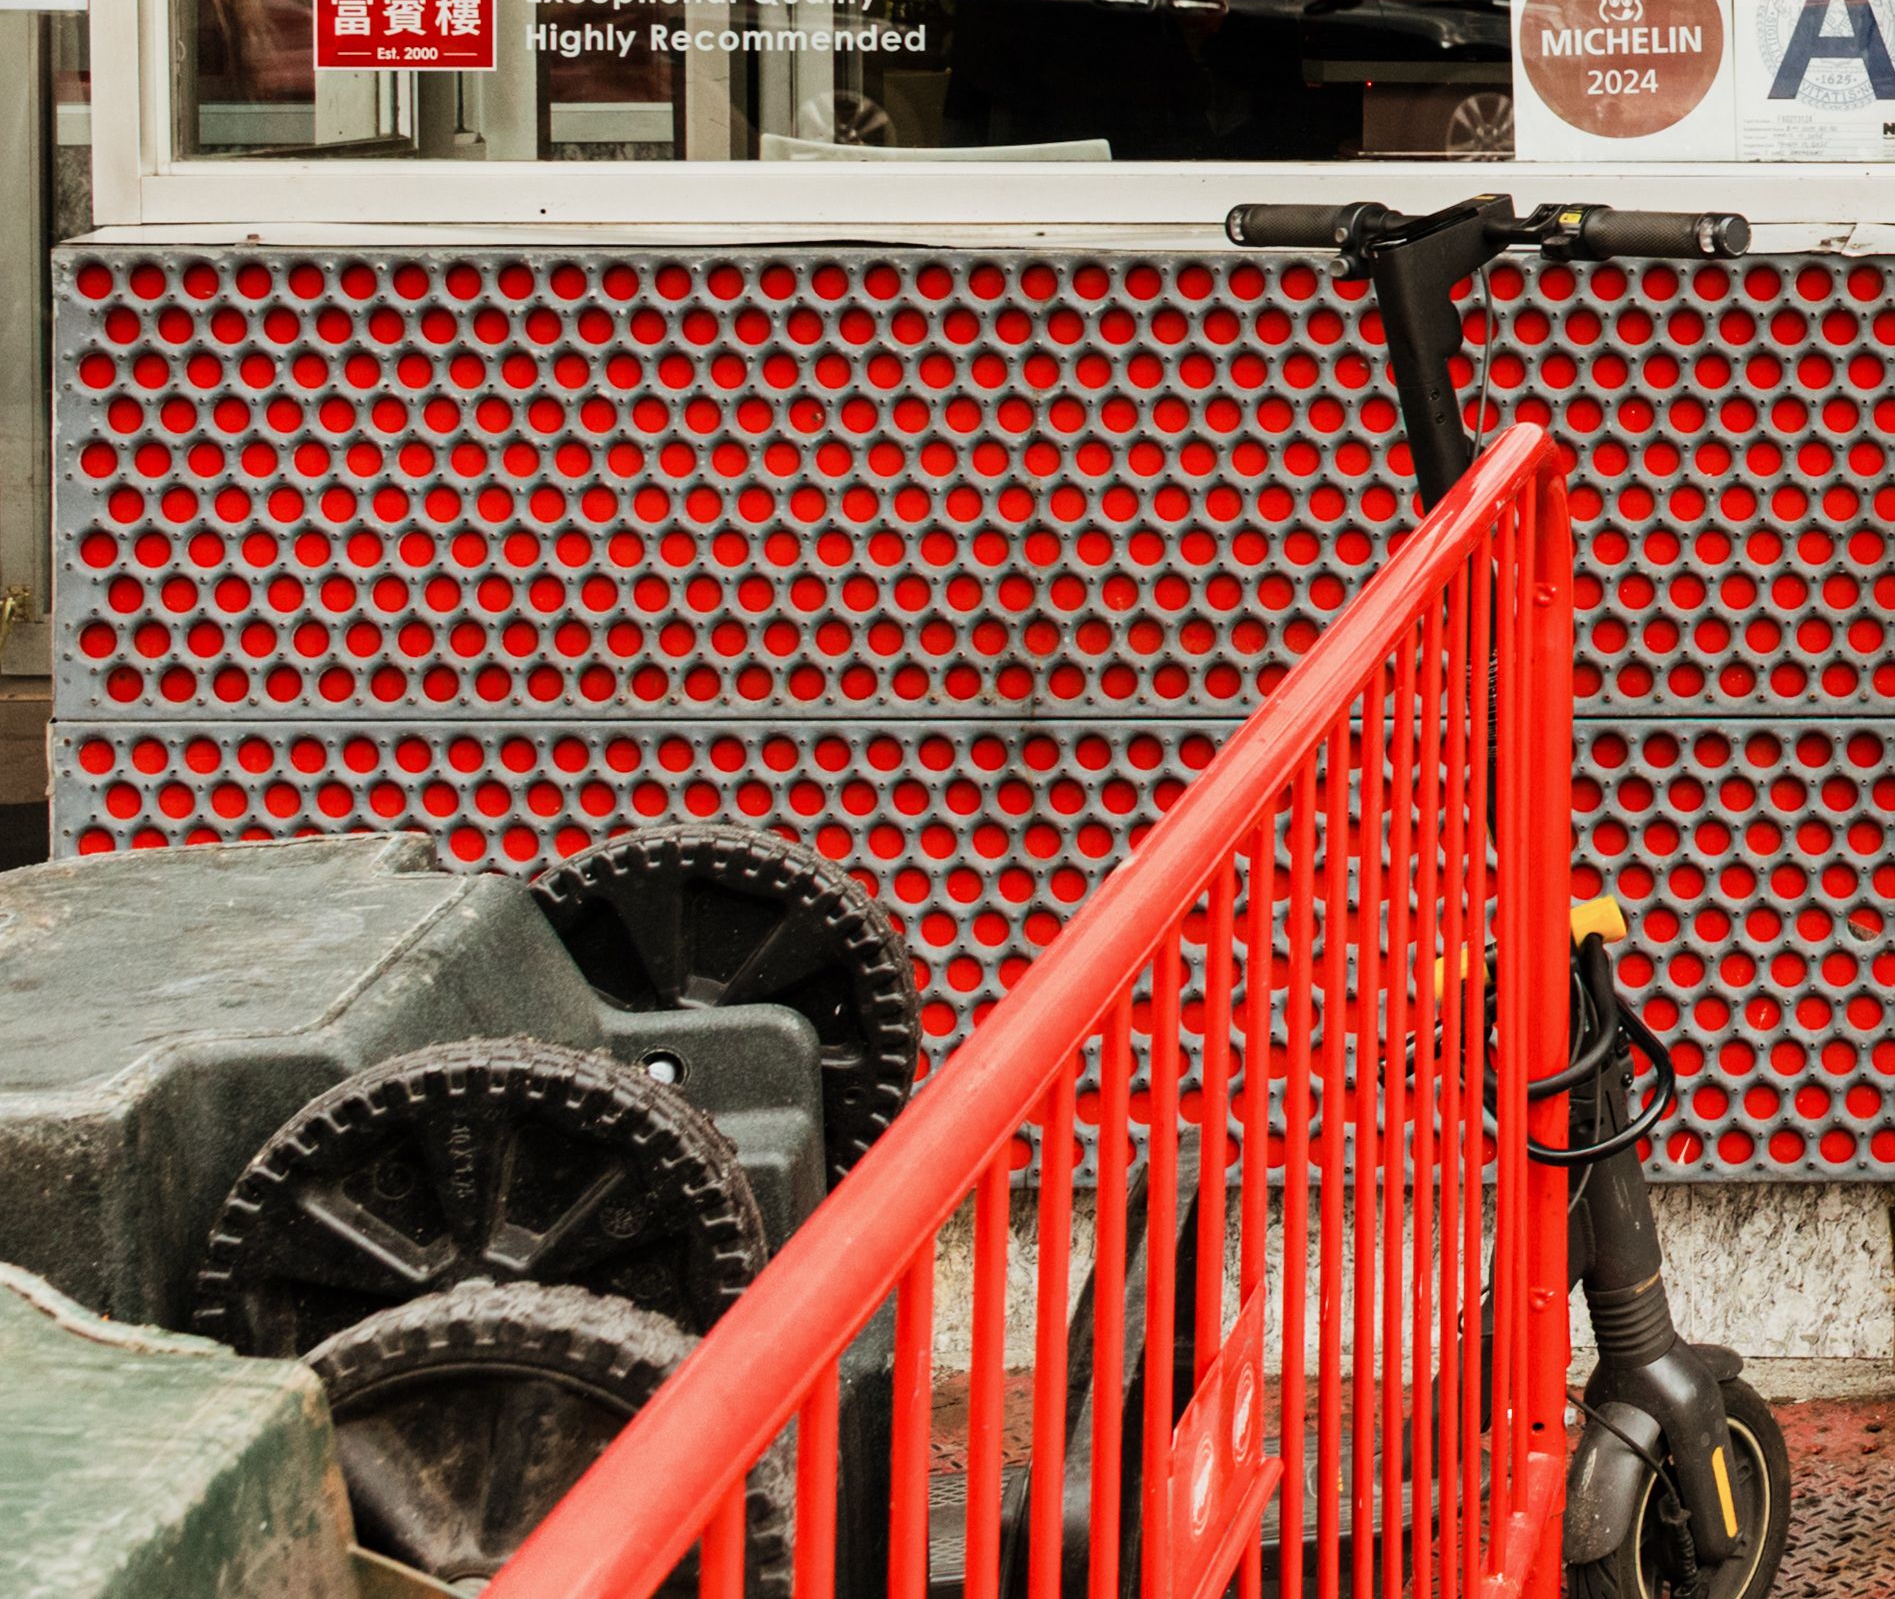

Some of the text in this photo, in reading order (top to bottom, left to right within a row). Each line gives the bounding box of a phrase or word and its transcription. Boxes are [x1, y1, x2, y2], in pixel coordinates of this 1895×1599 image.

[377, 47, 439, 60] Est. 2000
[525, 24, 927, 57] Highly Recommended
[1541, 25, 1703, 57] MICHELIN
[1586, 68, 1659, 95] 2024
[1821, 73, 1853, 85] 1625
